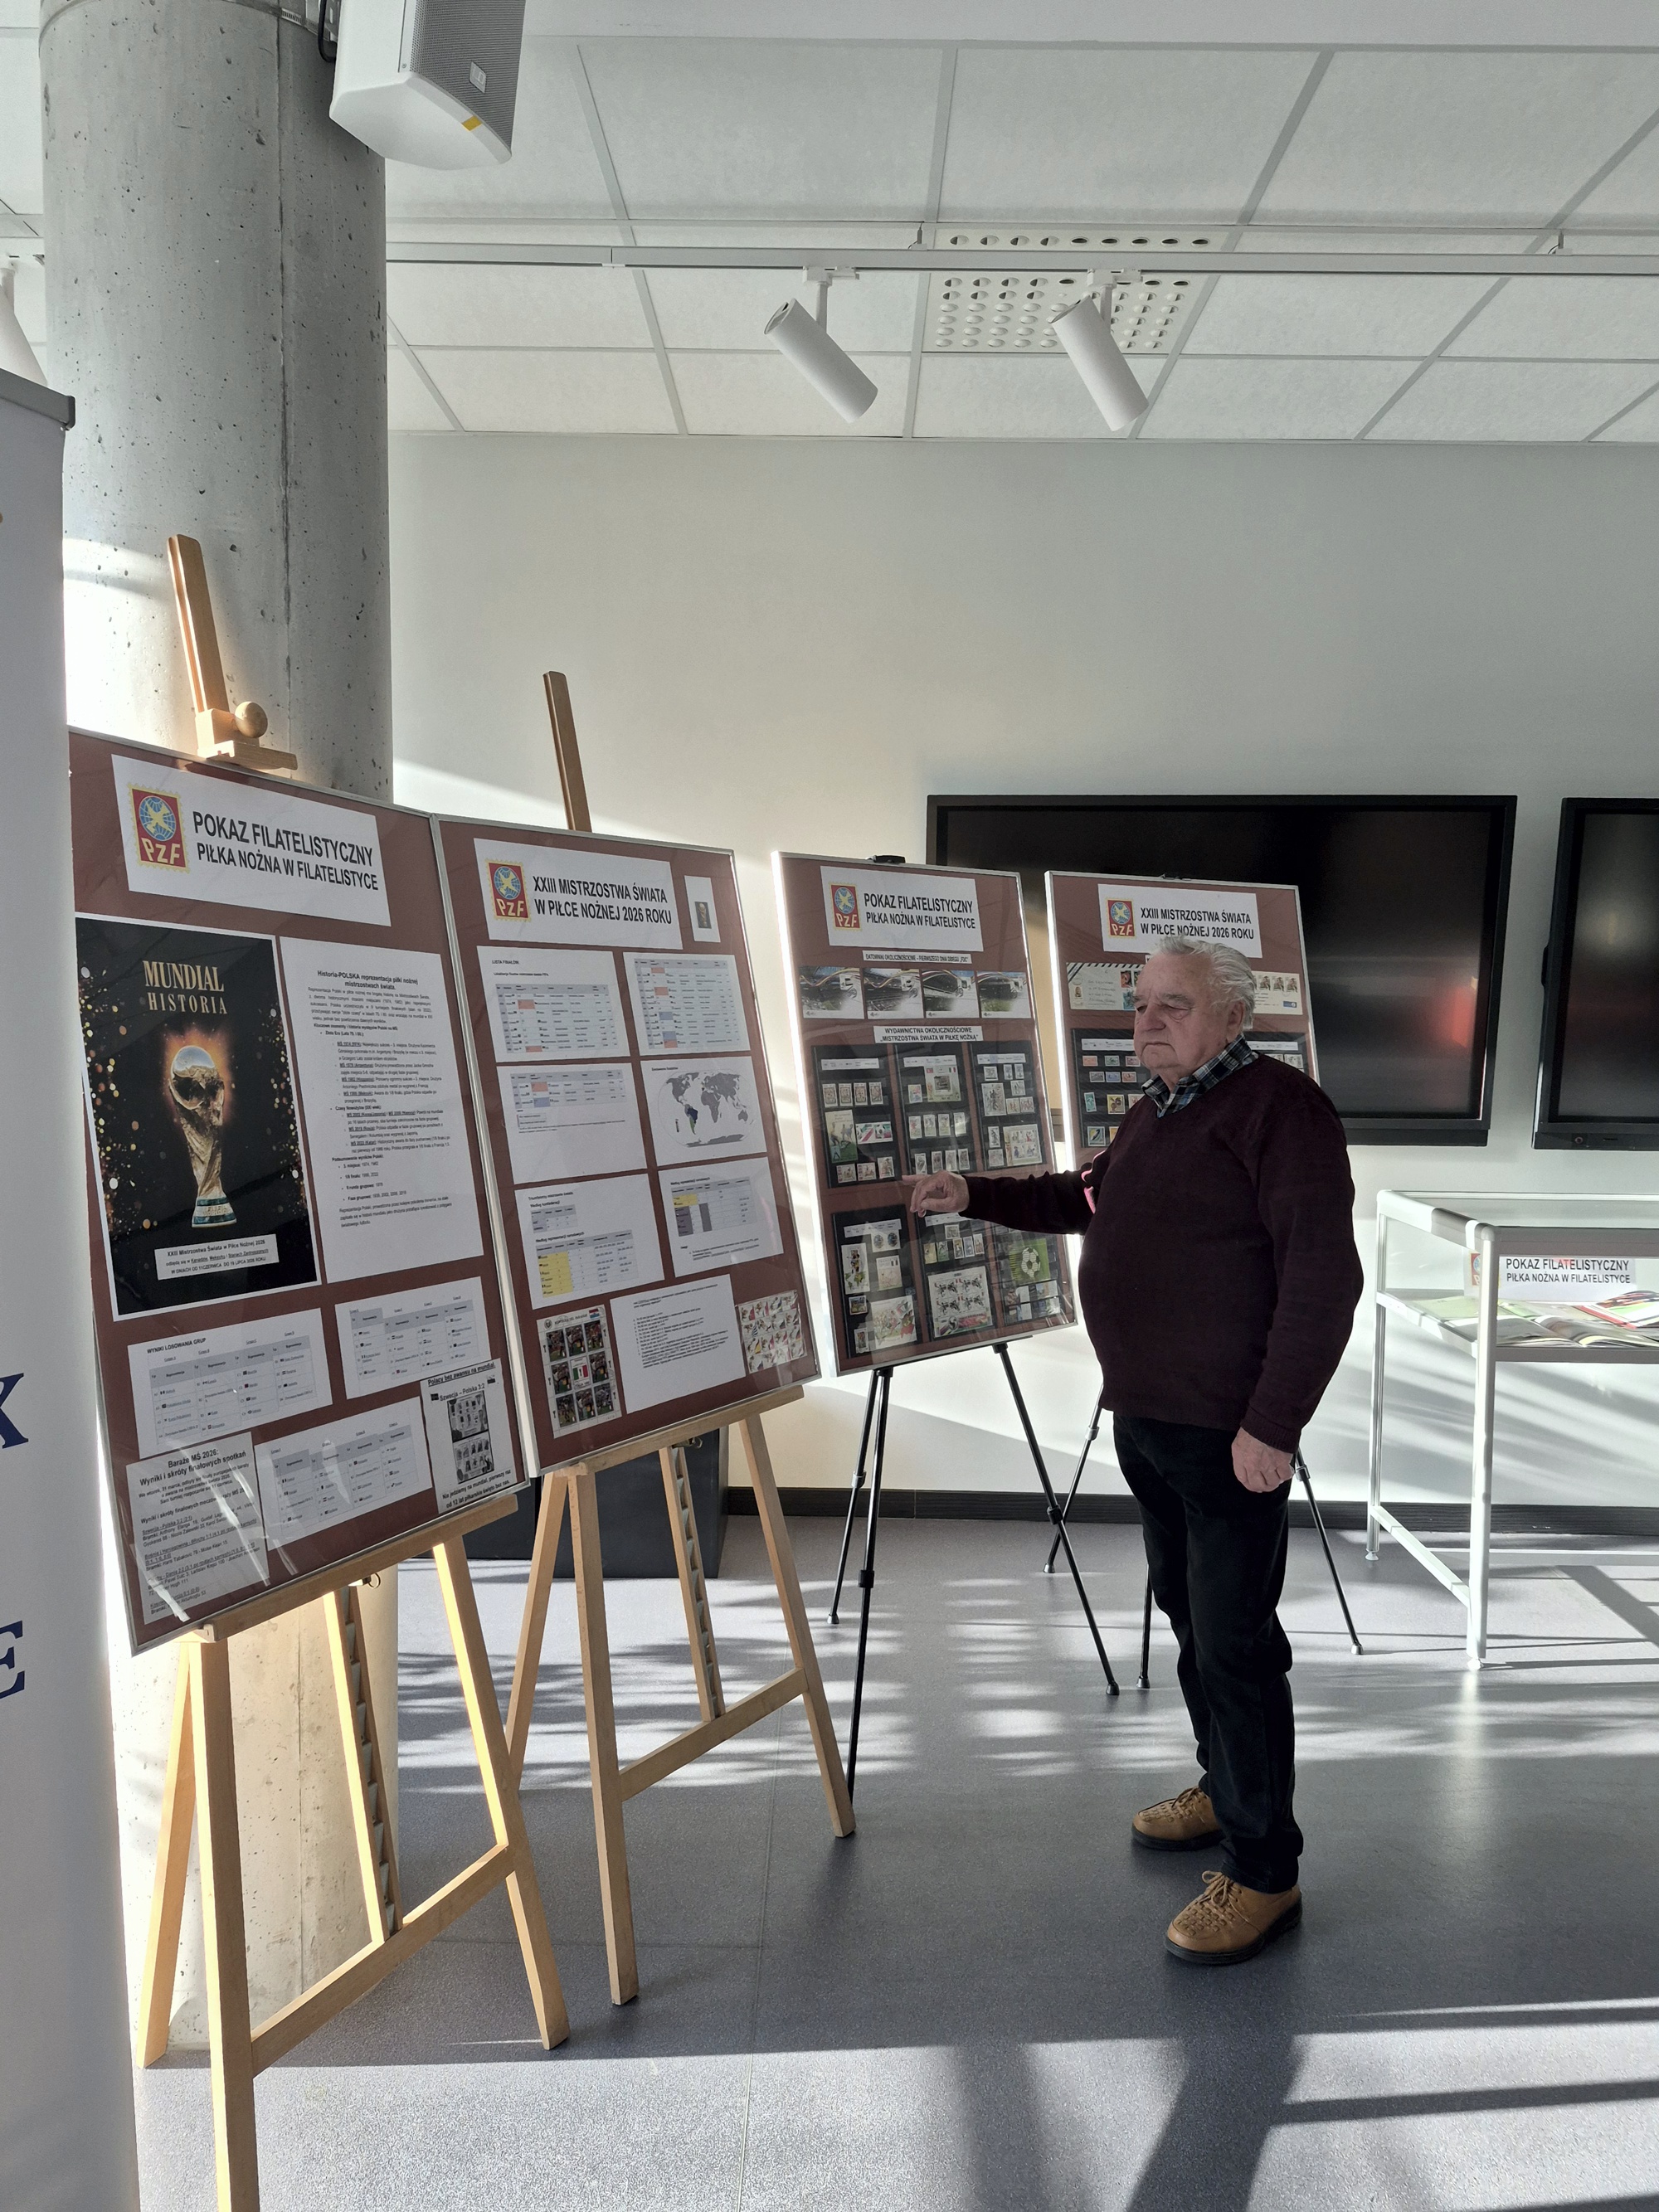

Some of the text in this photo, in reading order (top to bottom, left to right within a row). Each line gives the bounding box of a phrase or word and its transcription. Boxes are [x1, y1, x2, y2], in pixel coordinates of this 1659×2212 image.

[192, 811, 372, 867] POKAZ FILATELISTYCZNY
[197, 843, 378, 891] PIŁKA NOŻNA W FILATELISTYCE
[533, 876, 667, 903] XXIII MISTRZOSTWA ŚWIATA
[535, 899, 671, 924] W PIŁCE NOŻNEJ 2026 ROKU
[864, 893, 972, 913] POKAZ FILATELISTYCZNY
[866, 912, 975, 929] PIŁKA NOŻNA W FILATELISTYCE
[1141, 907, 1251, 924] XXIII MISTRZOSTWA ŚWIATA
[1141, 923, 1253, 939] W PIŁCE NOŻNEJ 2026 ROKU
[143, 960, 224, 991] MUNDIAL
[318, 970, 360, 980] Historia-POLSKA
[362, 975, 392, 983] reprezentacja
[148, 993, 227, 1014] HISTORIA
[1506, 1258, 1629, 1271] POKAZ FILATELISTYCZNY
[1507, 1271, 1630, 1283] PIŁKA NOŻNA W FILATELISTYCE
[428, 1376, 444, 1386] Polacy
[454, 1370, 470, 1378] awansu
[440, 1392, 458, 1402] Szwecja
[463, 1385, 477, 1395] Polska
[168, 1449, 219, 1468] Baraże MŚ 2026:
[140, 1474, 163, 1486] Wyniki
[168, 1466, 187, 1478] skróty
[188, 1457, 221, 1472] finałowych
[223, 1451, 246, 1464] spotkań
